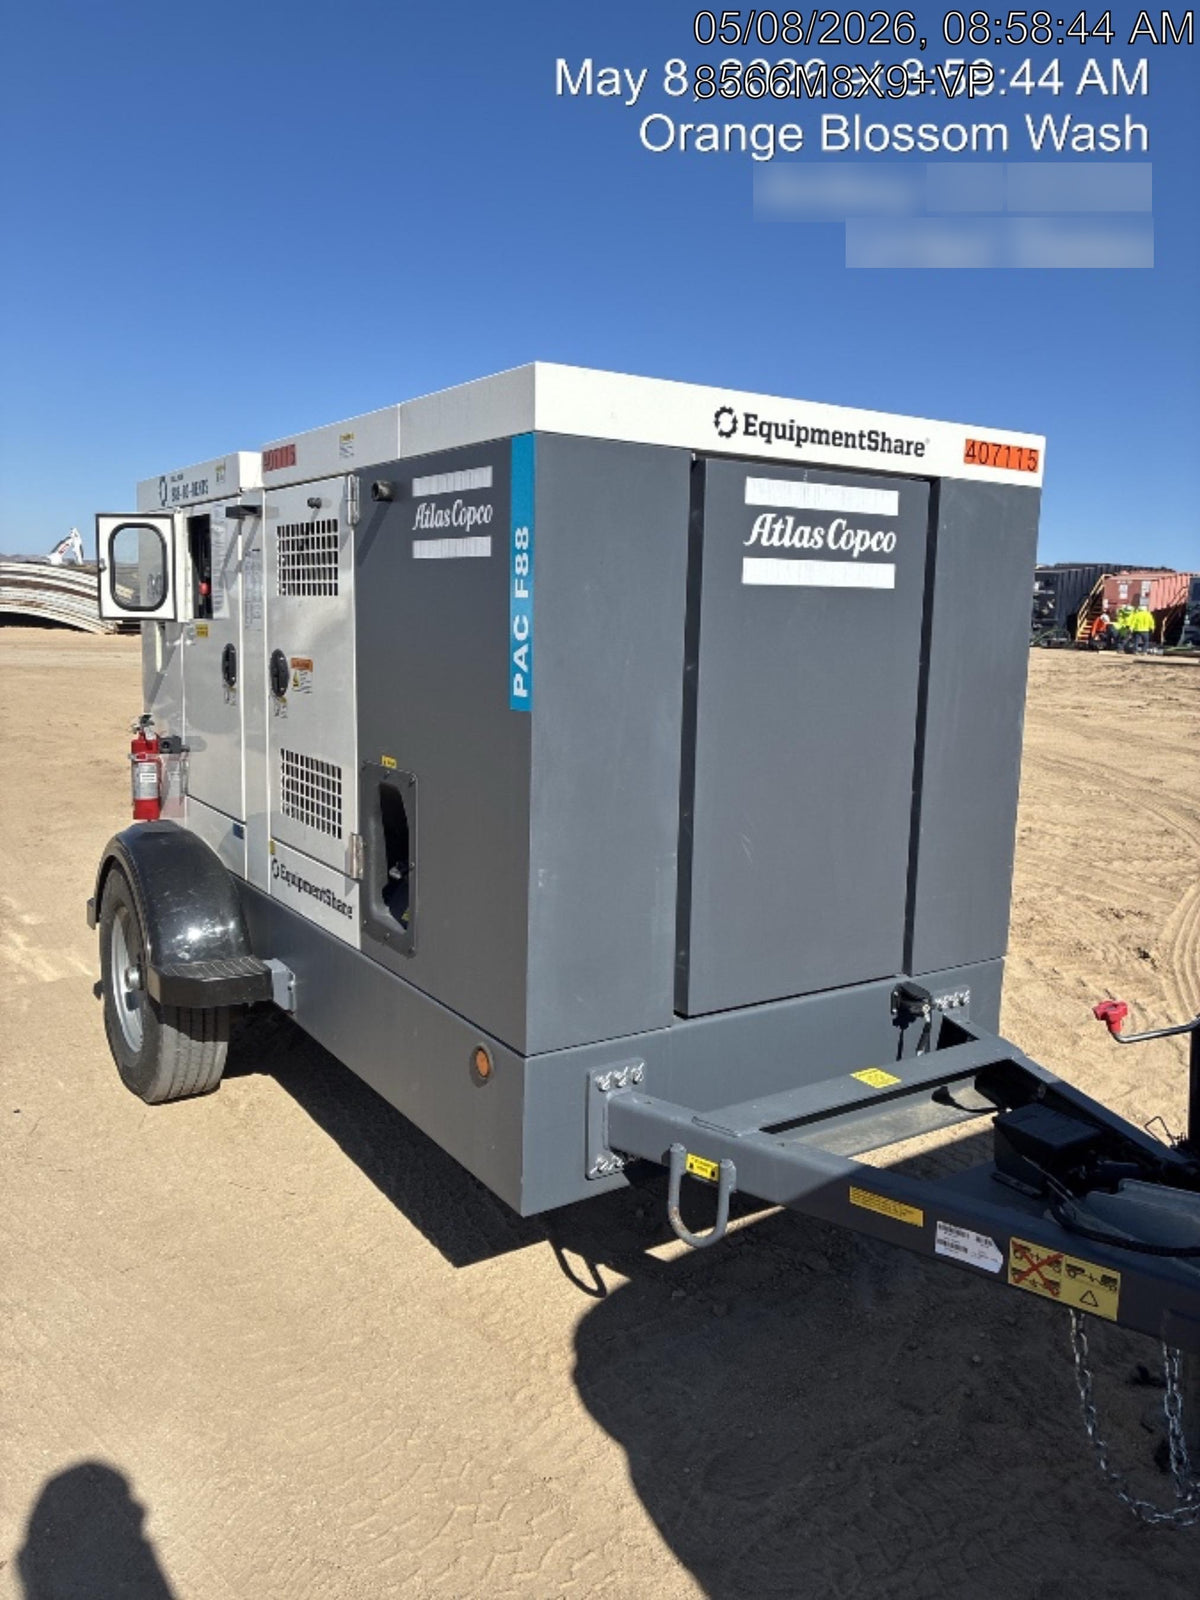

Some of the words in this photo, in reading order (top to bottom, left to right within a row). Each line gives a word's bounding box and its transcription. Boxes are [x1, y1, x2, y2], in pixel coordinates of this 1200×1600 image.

[743, 412, 926, 457] EquipmentShare
[965, 439, 1039, 472] 407115
[514, 526, 529, 599] F88
[513, 614, 529, 698] PAC
[280, 863, 353, 920] EquipmentShare
